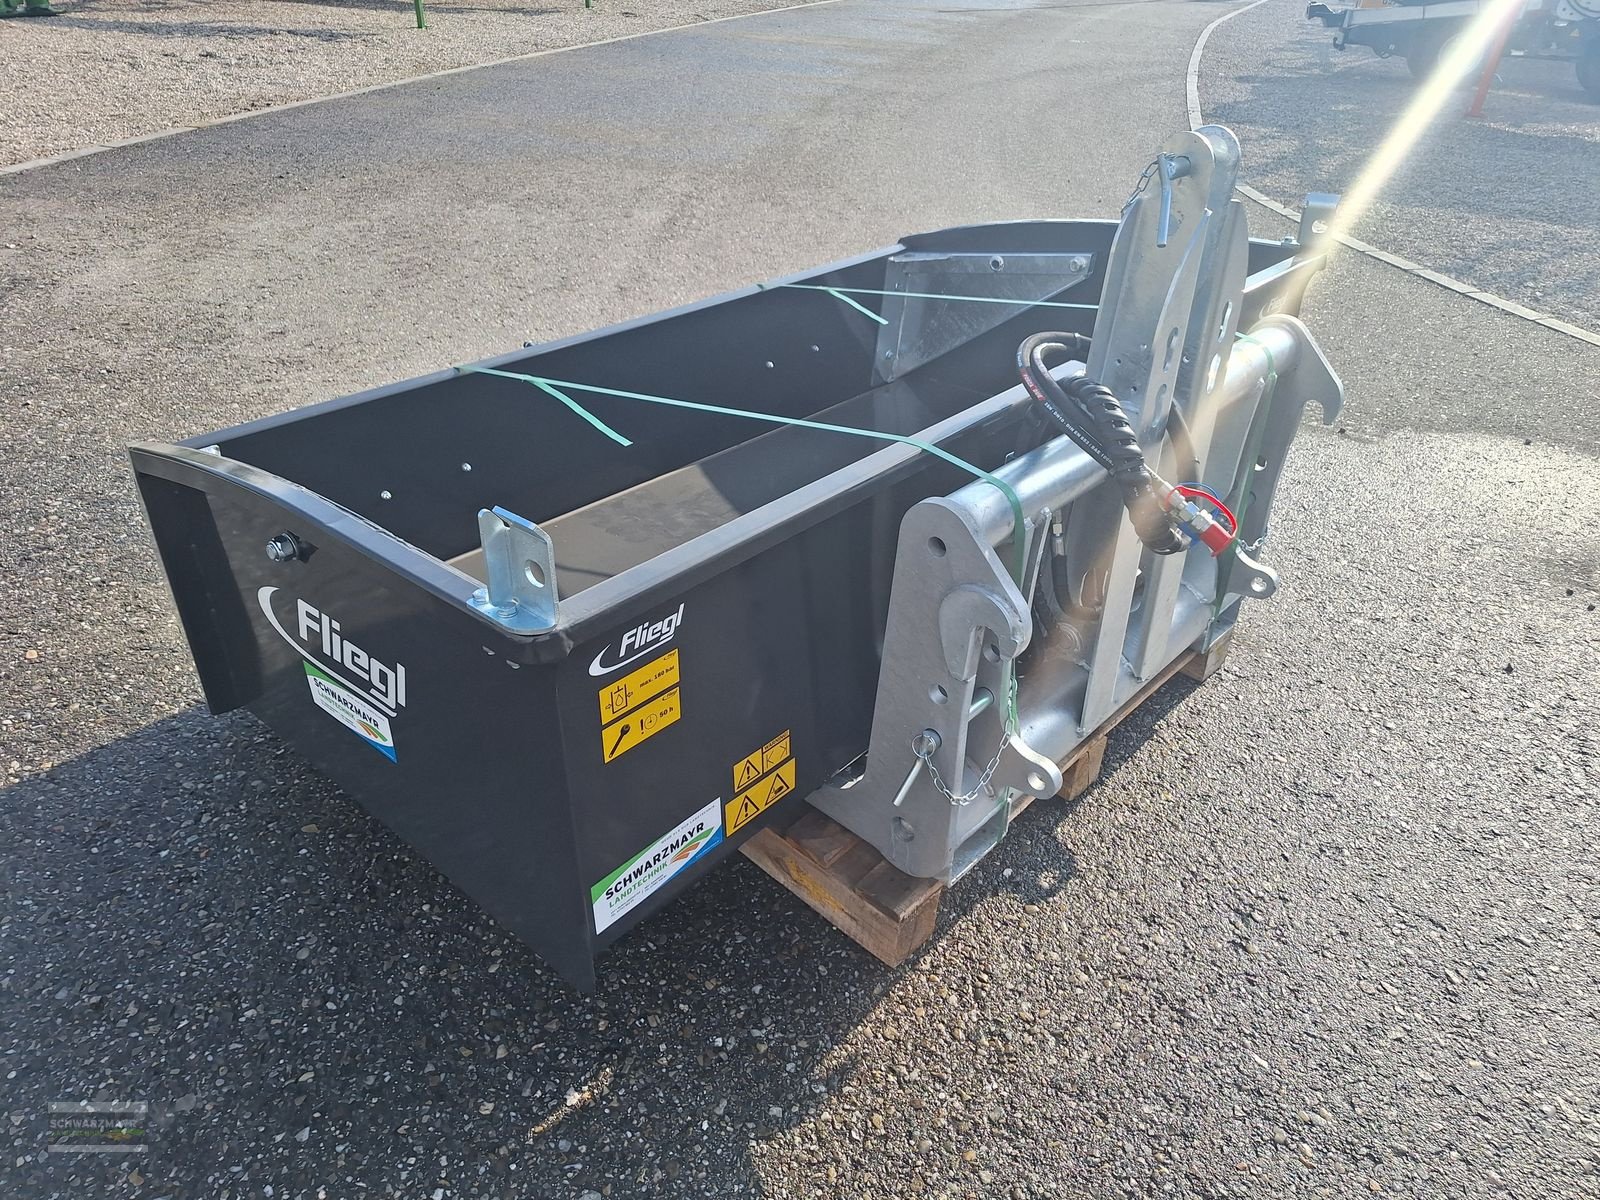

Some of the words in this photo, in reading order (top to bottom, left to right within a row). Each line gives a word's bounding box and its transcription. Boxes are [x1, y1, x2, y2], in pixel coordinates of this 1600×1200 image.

[297, 598, 406, 710] Fliegl
[619, 603, 685, 658] Fliegl
[313, 677, 380, 729] SCHWARZMAYR
[659, 709, 668, 718] 50
[669, 706, 674, 715] h
[605, 822, 705, 900] SCHWARZMAYR
[609, 861, 668, 909] LANDTECHNIK
